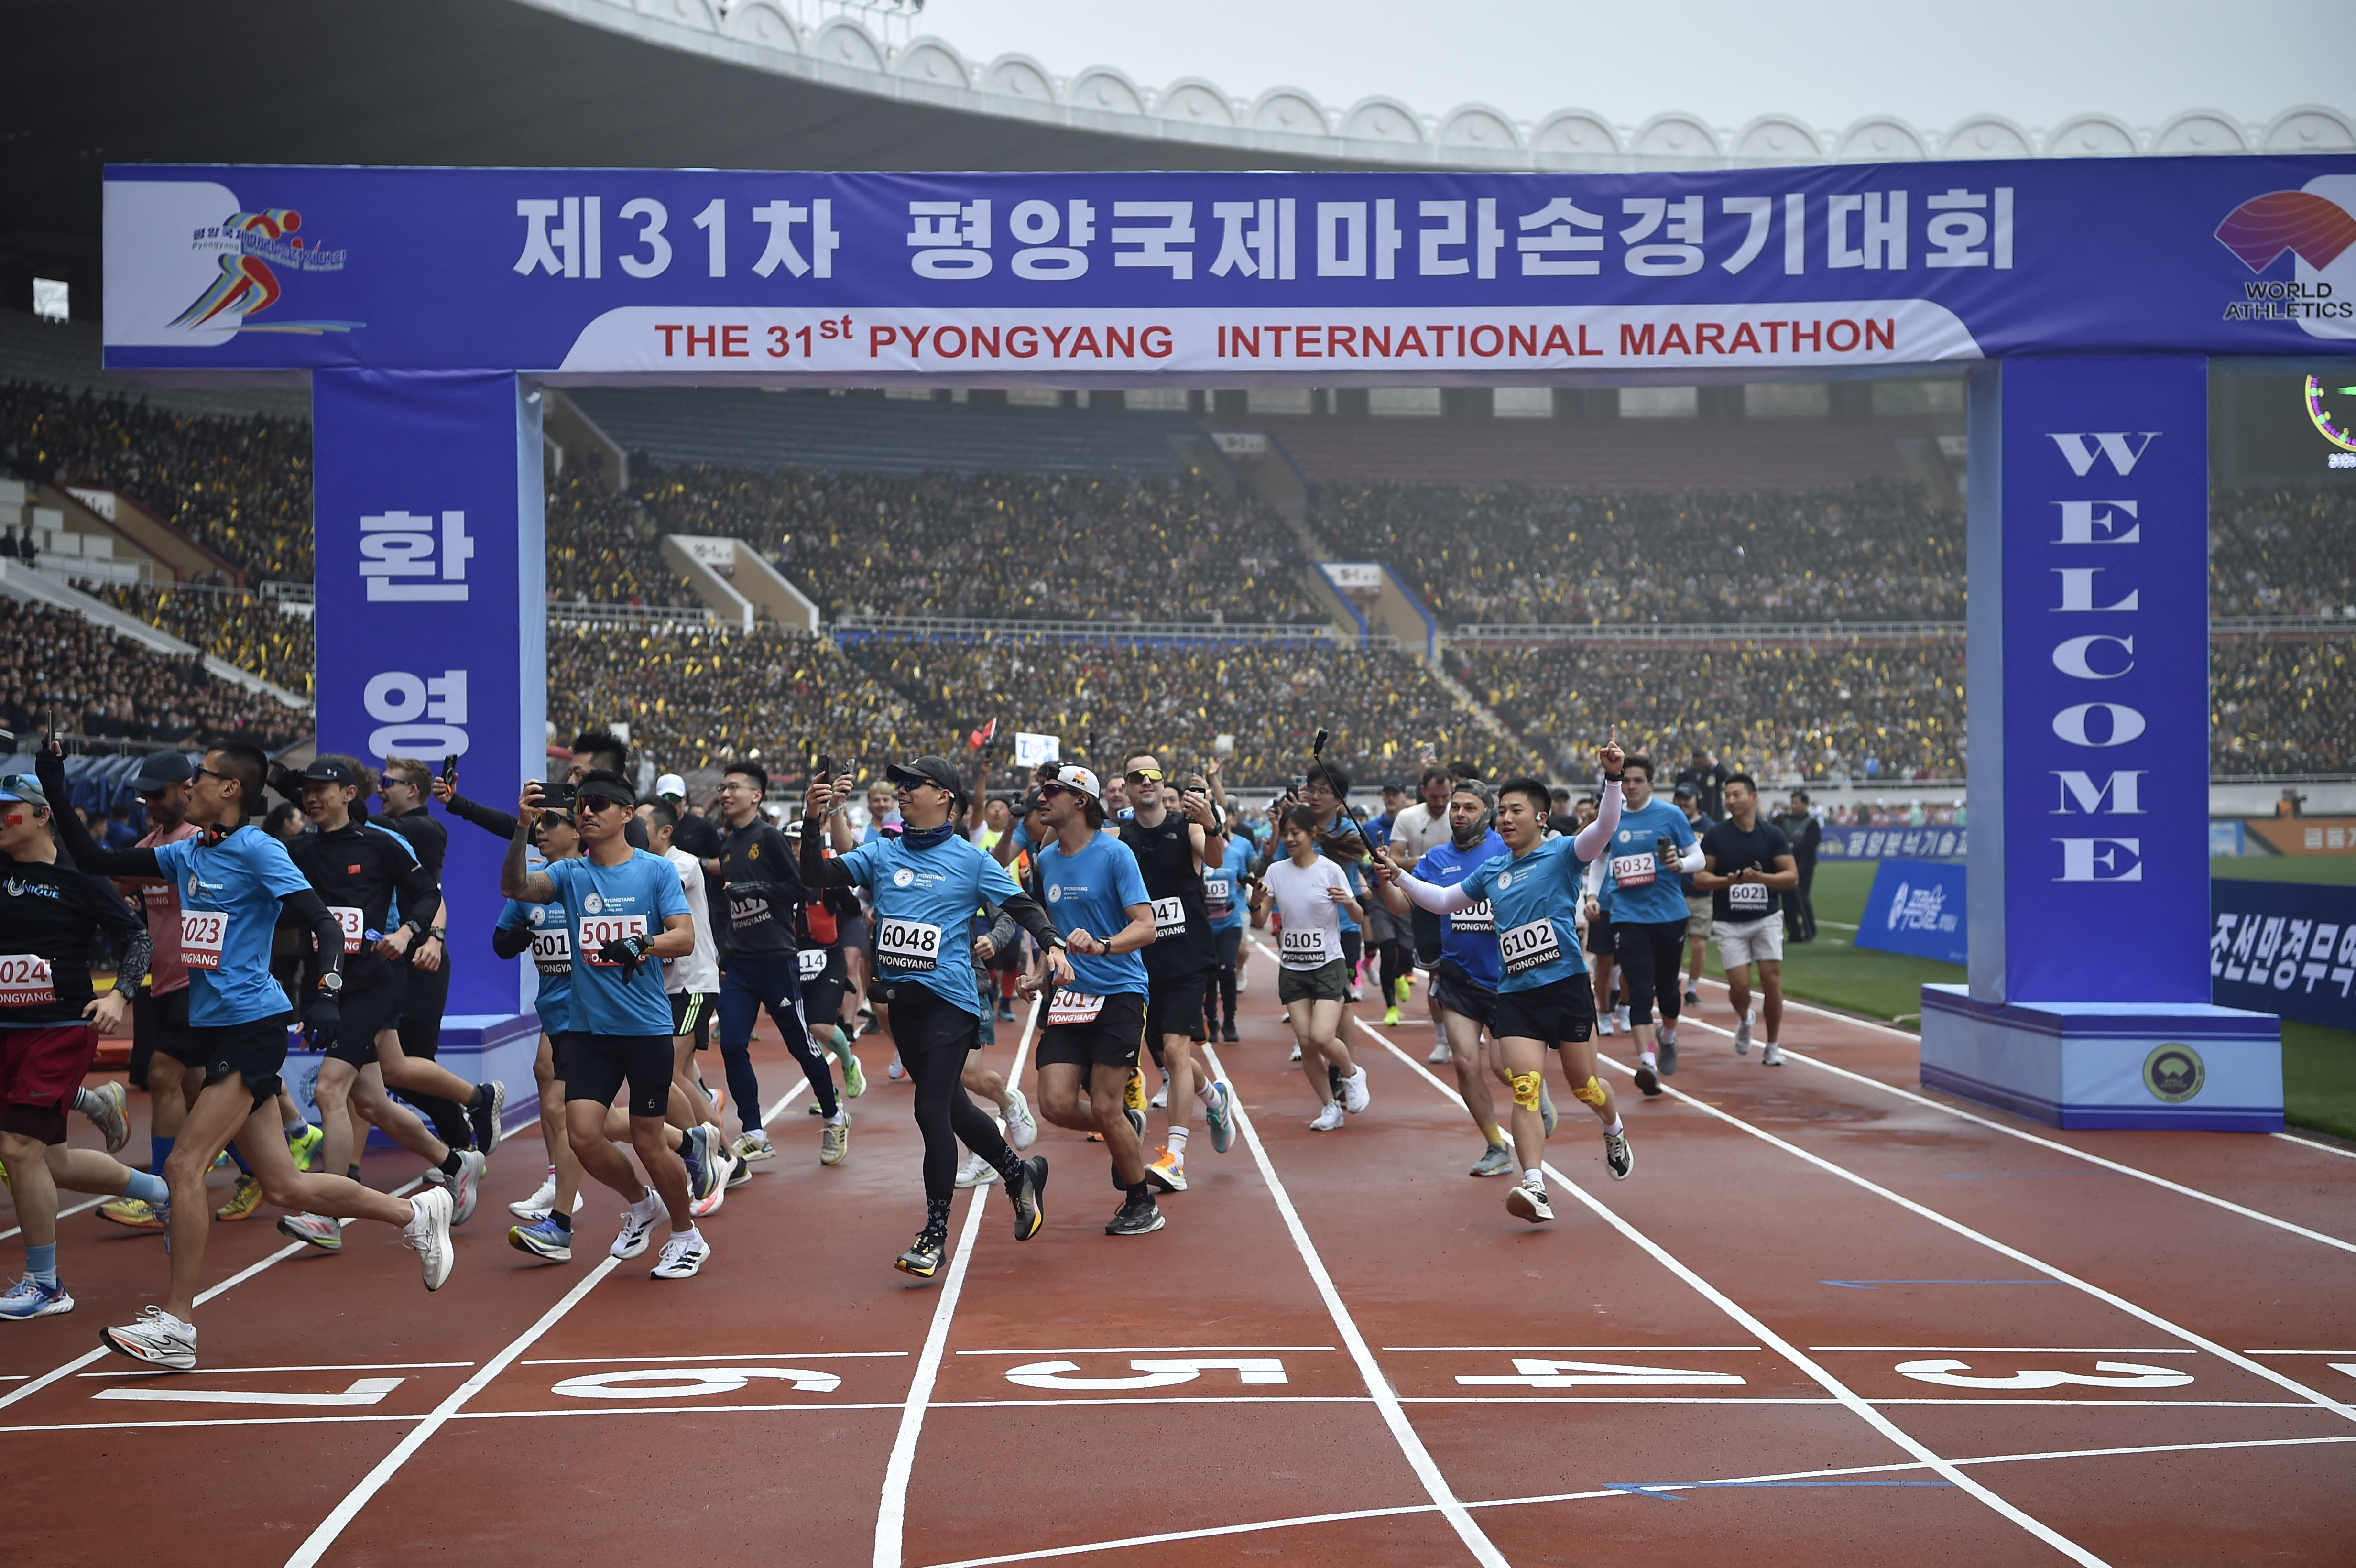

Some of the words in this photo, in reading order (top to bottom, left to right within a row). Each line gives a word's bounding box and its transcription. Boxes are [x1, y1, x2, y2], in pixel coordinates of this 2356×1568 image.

[513, 196, 840, 278] 제31차
[907, 187, 2014, 280] 평양국제마라손경기대회
[2245, 280, 2332, 302] WORLD
[2223, 301, 2354, 320] ATHLETICS
[656, 326, 749, 357] THE
[768, 316, 852, 357] 31st
[871, 327, 1172, 358] PYONGYANG
[1219, 325, 1603, 357] INTERNATIONAL
[1621, 319, 1894, 355] MARATHON
[2046, 432, 2163, 882] WELCOME
[917, 873, 946, 882] PYONGYANG
[1614, 857, 1652, 874] 5032
[1732, 887, 1767, 899] 6021
[883, 924, 936, 951] 6048
[1285, 932, 1322, 948] 6105
[1502, 924, 1552, 957] 6102
[878, 954, 935, 969] PYONGYANG
[1507, 949, 1560, 974] PYONGYANG
[1047, 1013, 1096, 1023] PYONGYANG
[551, 1367, 842, 1399] 6
[1003, 1358, 1289, 1390] 5
[1454, 1358, 1748, 1388] 4
[1894, 1359, 2195, 1389] 3
[91, 1377, 406, 1405] 7
